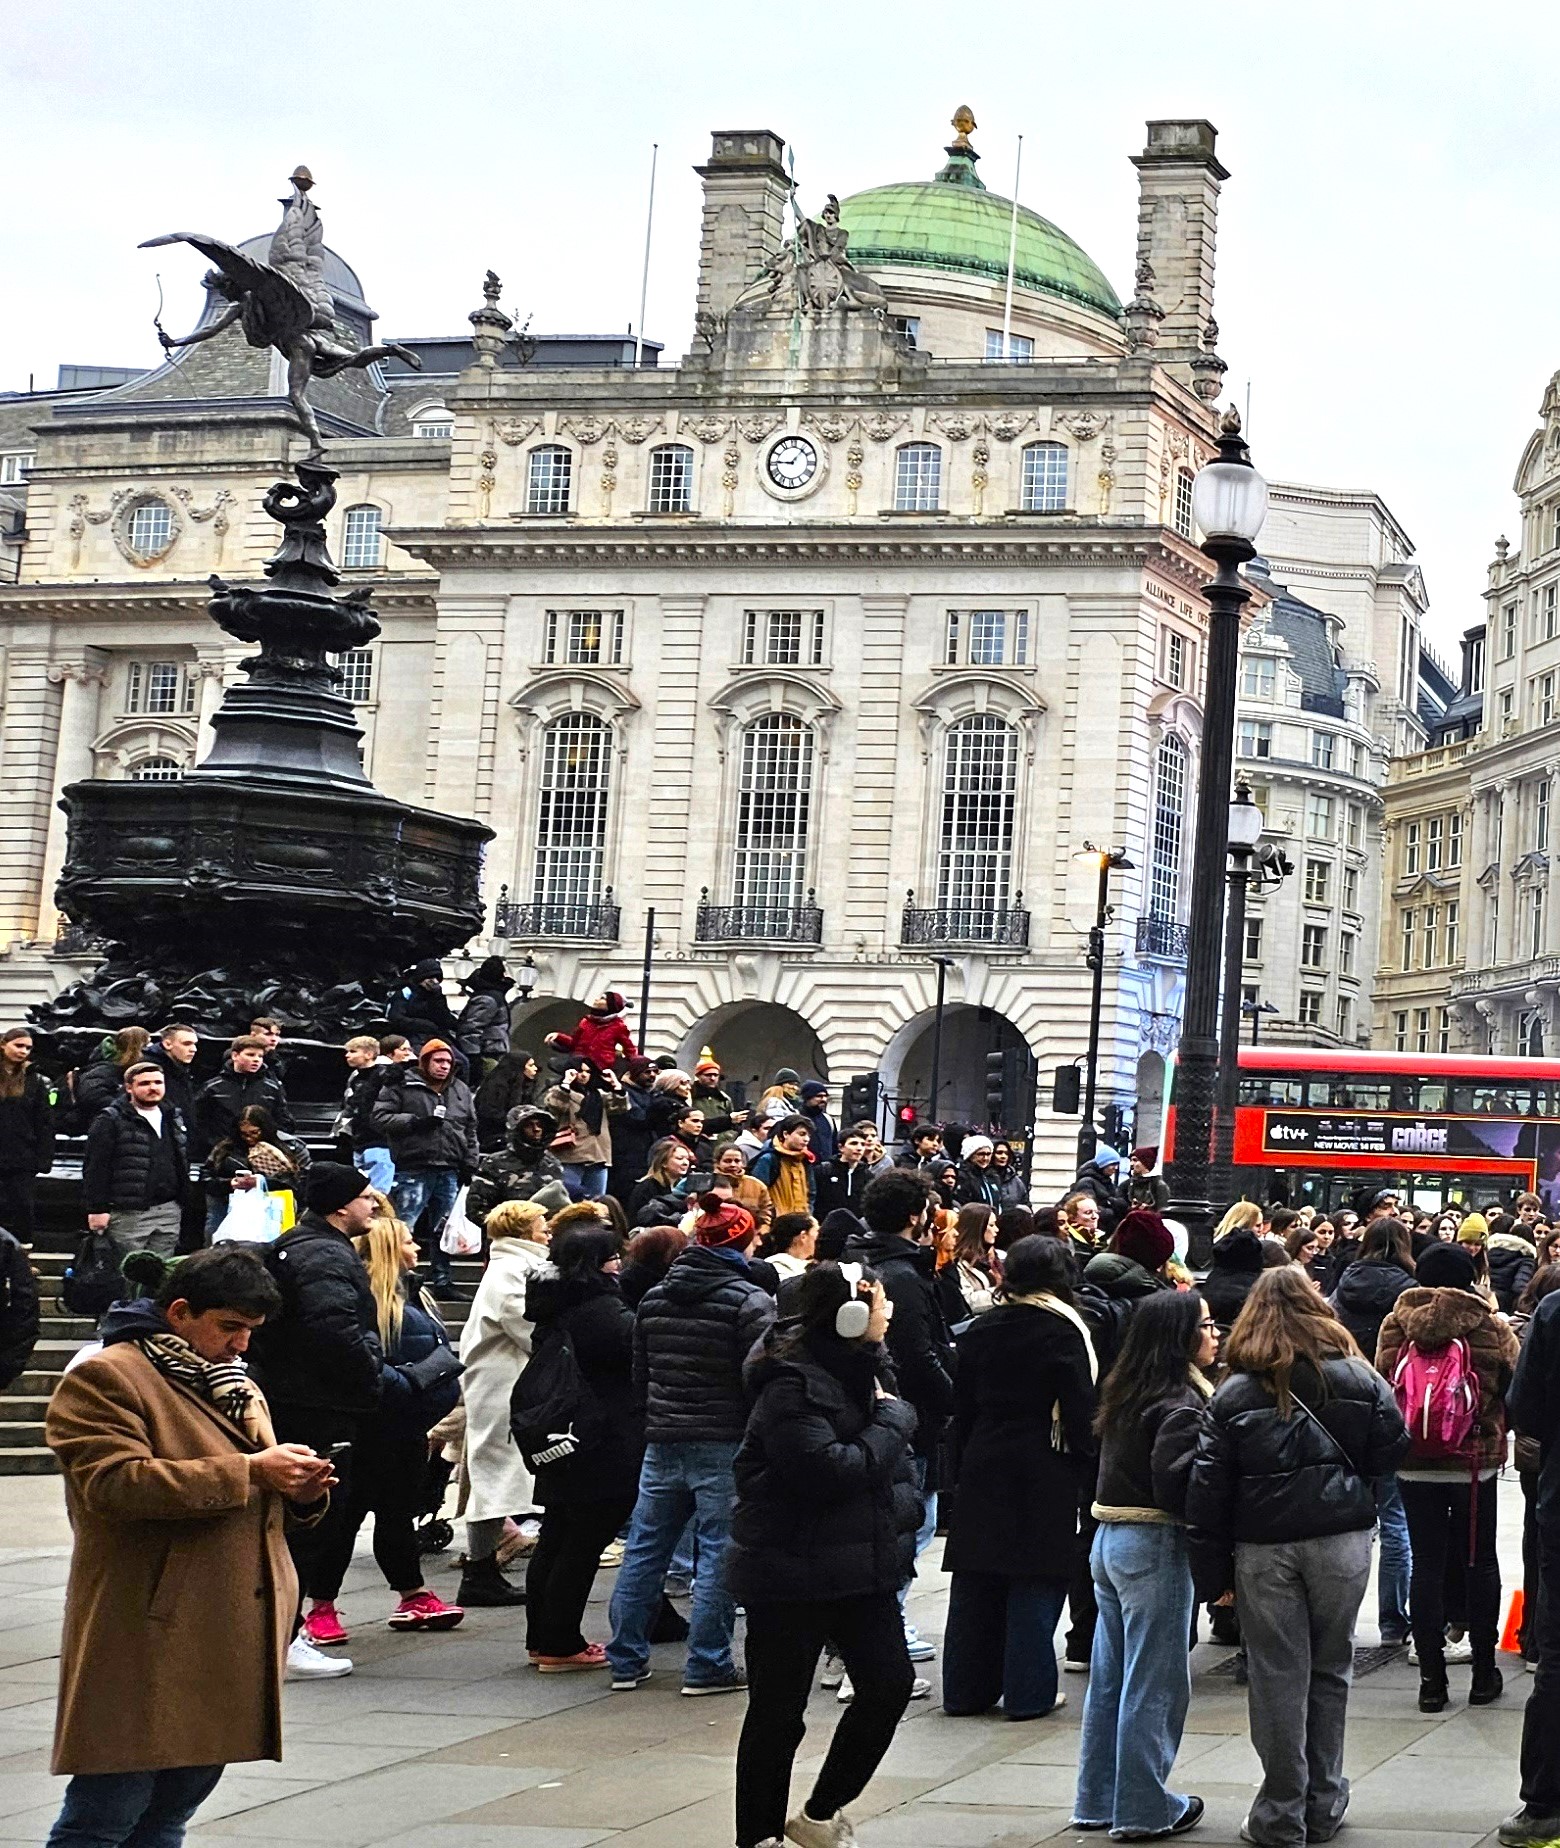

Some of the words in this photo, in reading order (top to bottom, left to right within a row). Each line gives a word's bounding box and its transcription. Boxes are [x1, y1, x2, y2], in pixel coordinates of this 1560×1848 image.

[1145, 580, 1176, 608] ALLIANCE
[1179, 600, 1193, 619] LIFE
[1283, 1126, 1309, 1140] tv+
[1392, 1126, 1448, 1152] GORGE
[1314, 1141, 1333, 1150] NEW
[1333, 1142, 1359, 1151] MOVIE
[1360, 1142, 1369, 1151] 14
[1369, 1142, 1386, 1152] FEB
[531, 1440, 575, 1466] PUMA
